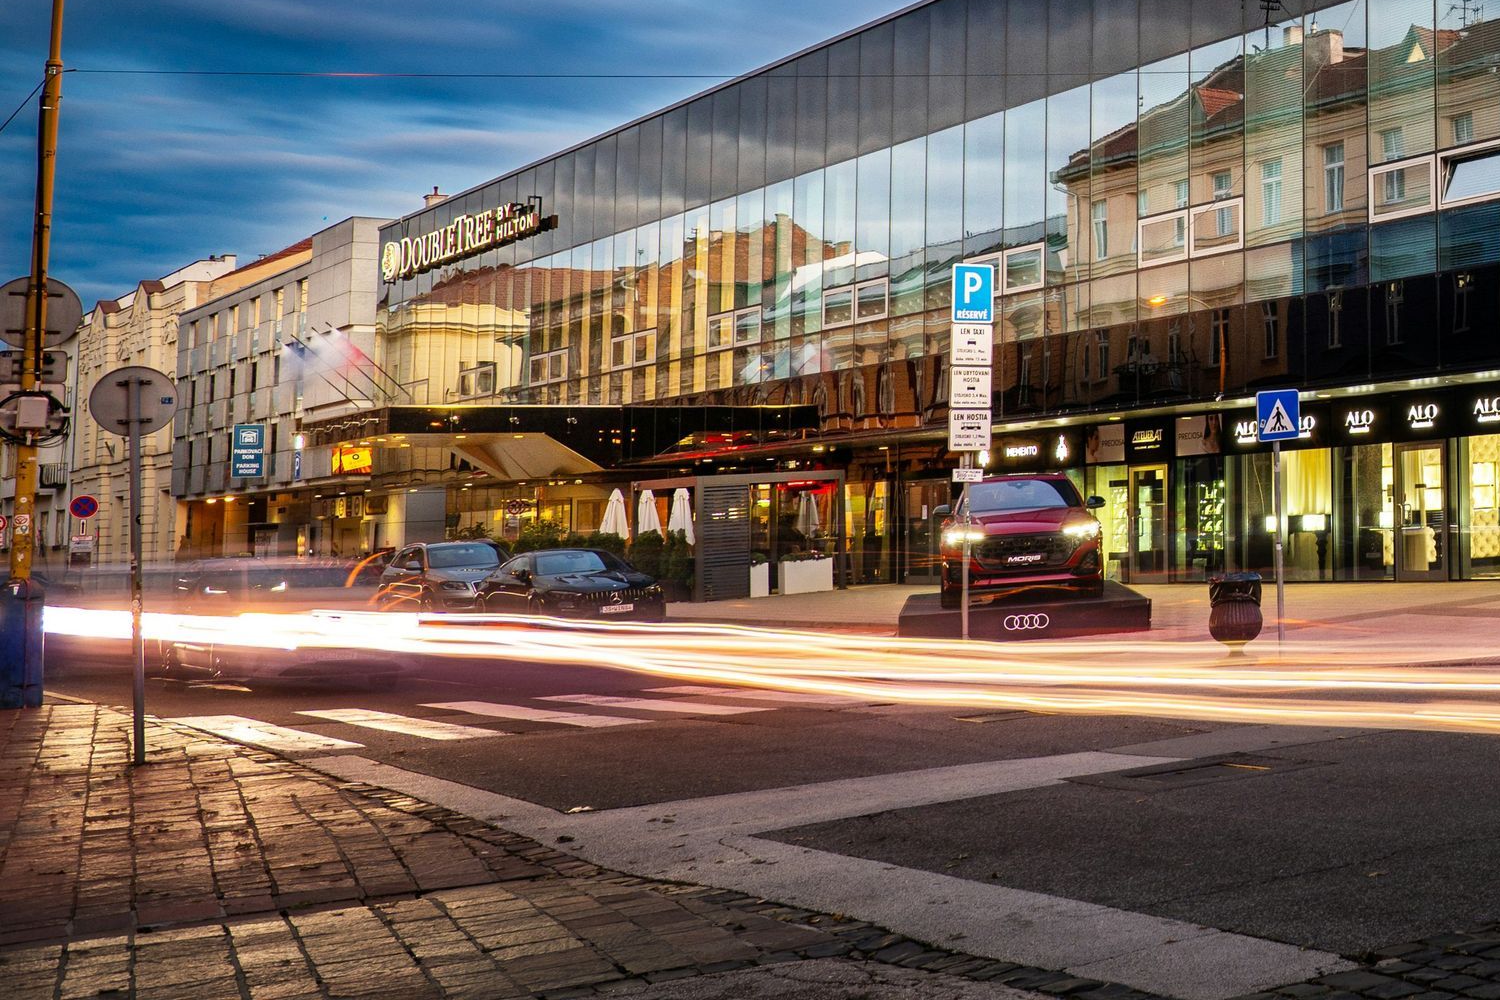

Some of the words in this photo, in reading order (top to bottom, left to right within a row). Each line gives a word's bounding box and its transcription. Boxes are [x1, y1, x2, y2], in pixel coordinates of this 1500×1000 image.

[497, 203, 512, 221] BY
[496, 214, 534, 239] HILTON
[399, 210, 492, 274] DOUBLETREE
[964, 271, 983, 304] P
[1345, 410, 1375, 427] ALO
[1407, 403, 1438, 421] ALO
[1178, 431, 1203, 440] PRECIOSA
[1006, 445, 1037, 457] MEMENTO
